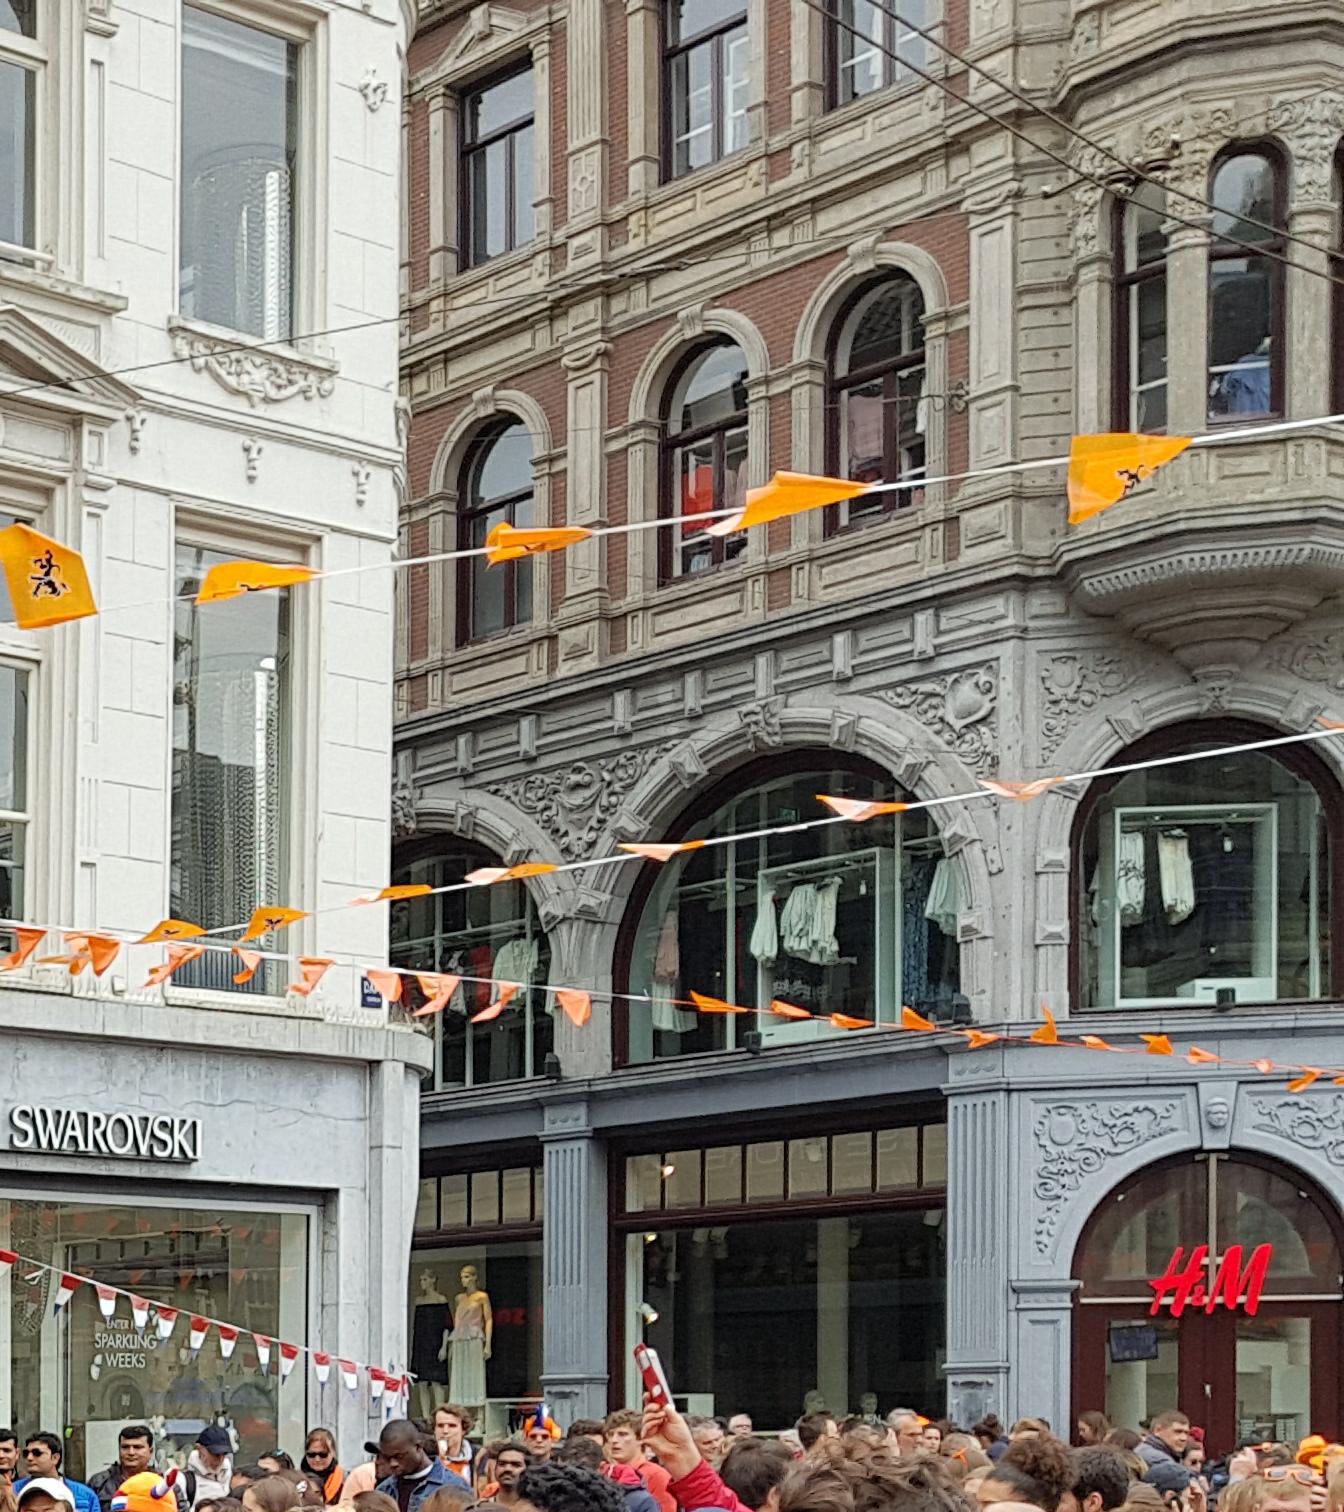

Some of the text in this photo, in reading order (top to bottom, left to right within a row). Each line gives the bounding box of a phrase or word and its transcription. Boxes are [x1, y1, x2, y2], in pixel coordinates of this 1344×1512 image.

[11, 1103, 204, 1159] SWAROVSKI
[1148, 1243, 1273, 1317] H&M
[94, 1332, 158, 1350] SPARKLING
[105, 1352, 146, 1369] WEEKS
